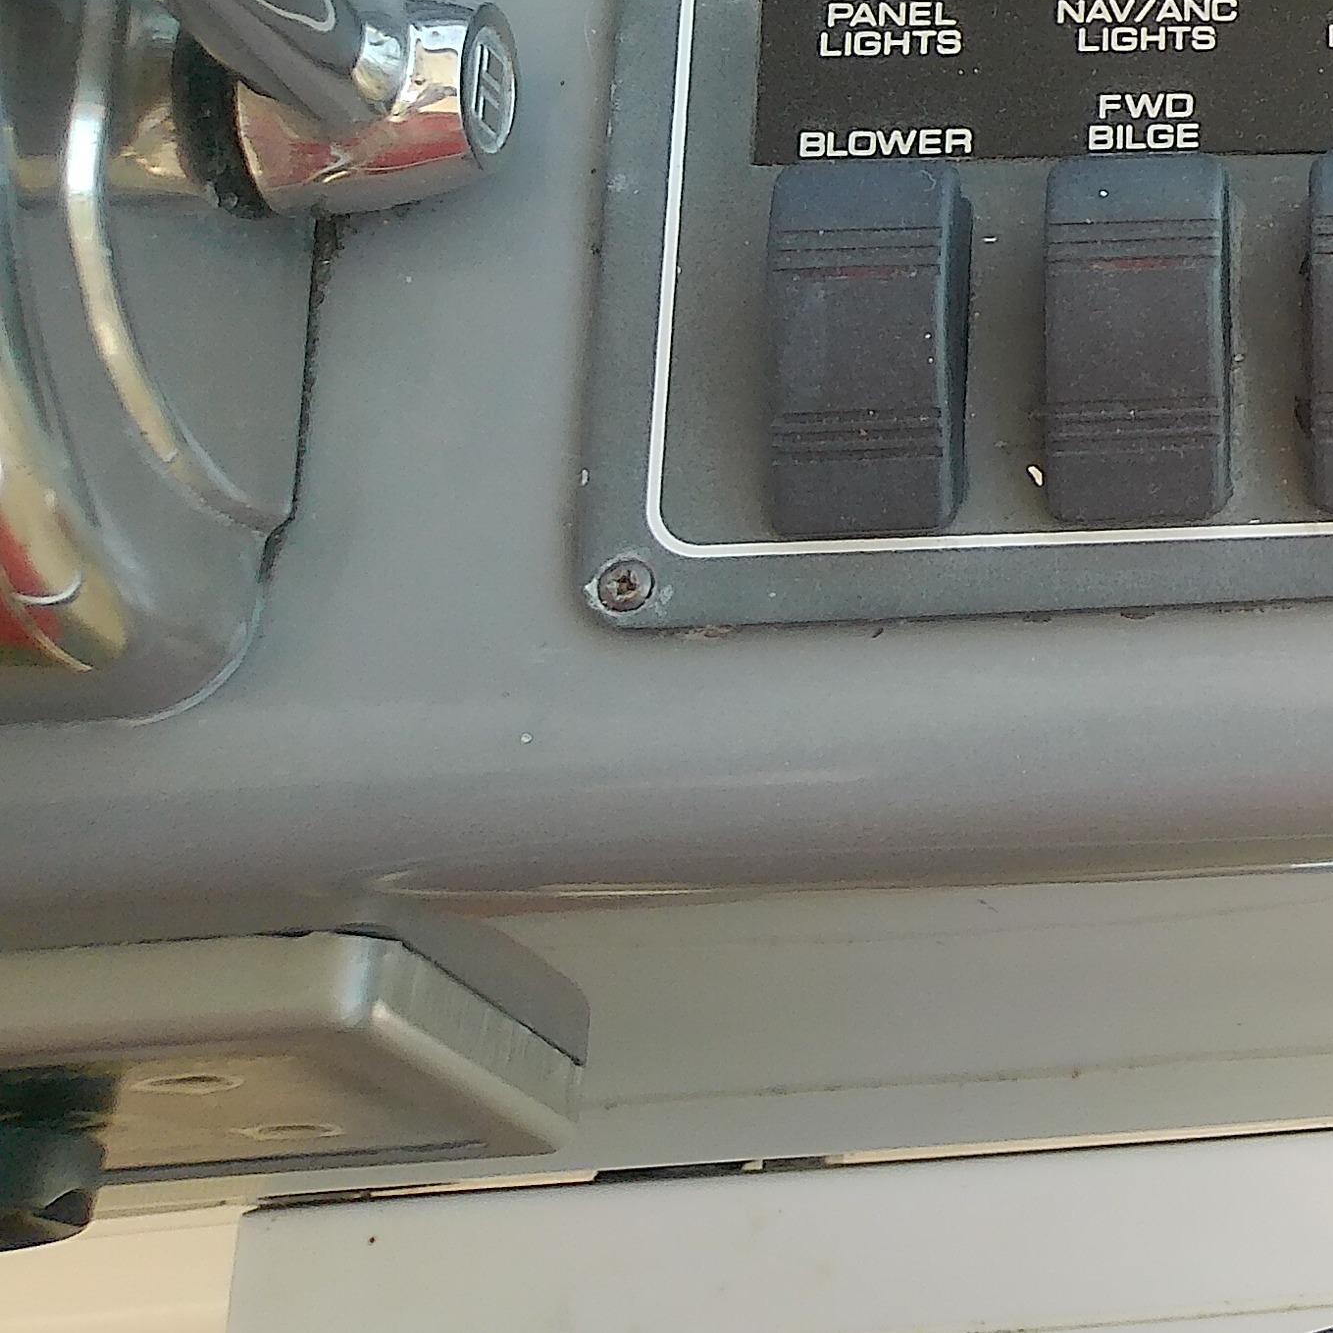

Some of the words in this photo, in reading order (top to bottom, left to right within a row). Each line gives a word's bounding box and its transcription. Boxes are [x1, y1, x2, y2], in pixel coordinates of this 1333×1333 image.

[827, 1, 957, 27] PANEL
[819, 30, 963, 57] LIGHTS
[1078, 25, 1217, 53] LIGHTS
[1099, 93, 1194, 120] FWD
[800, 128, 972, 158] BLOWER
[1088, 123, 1199, 152] BILGE
